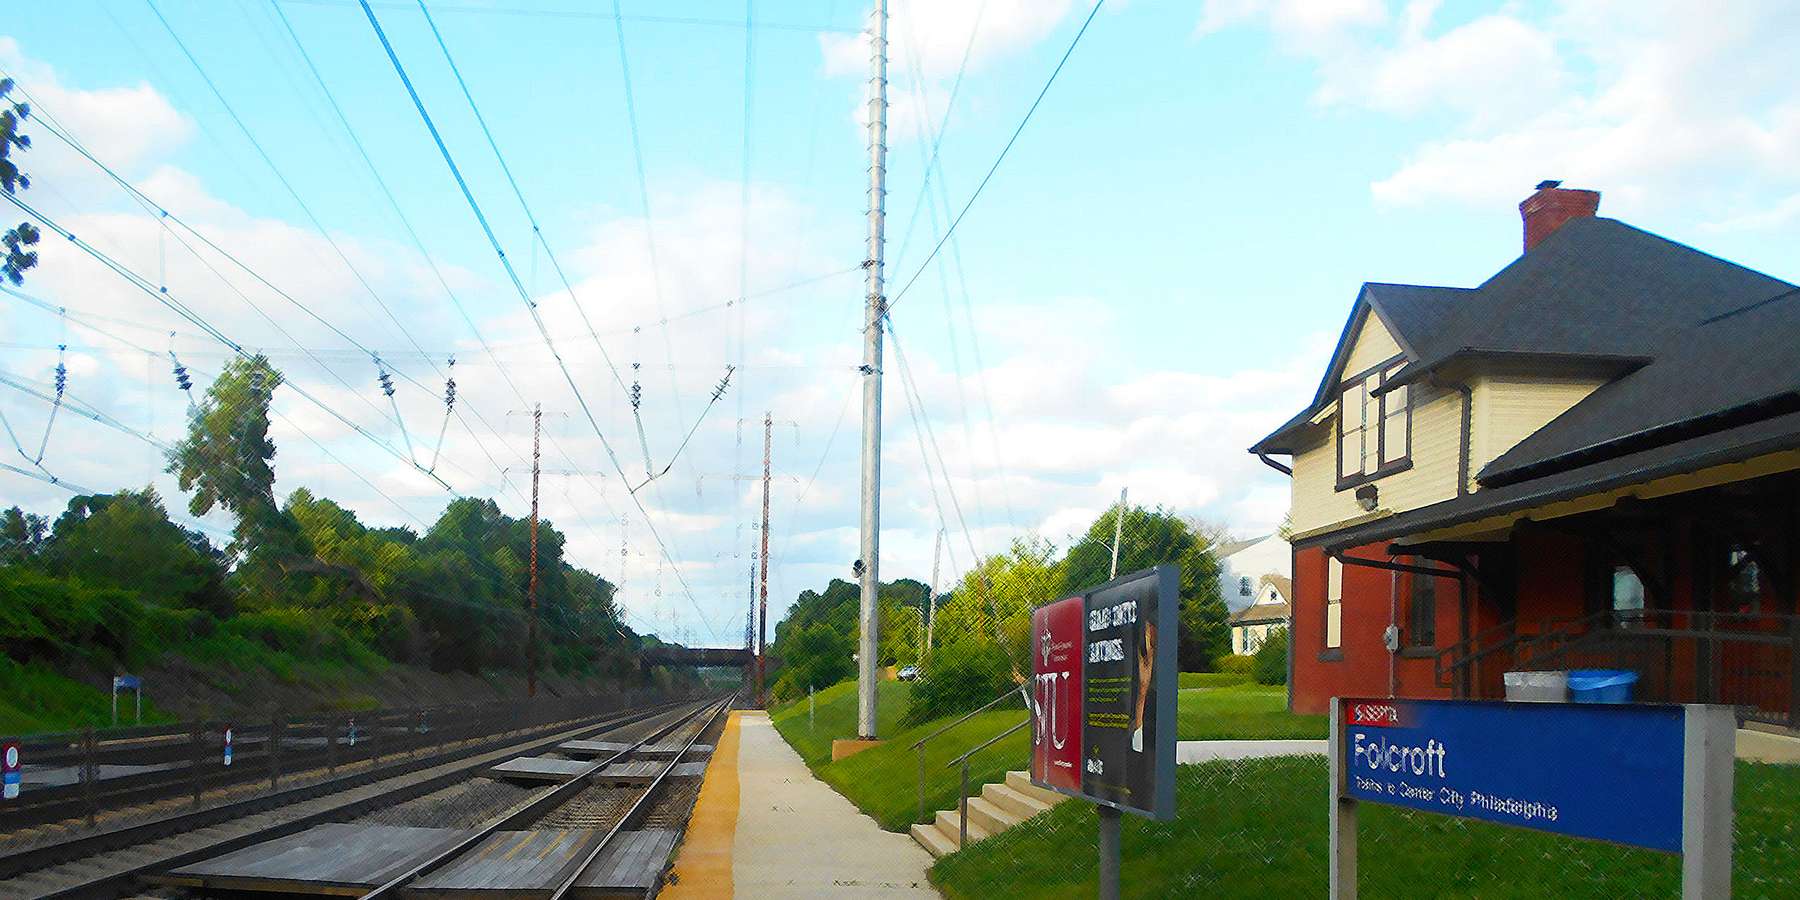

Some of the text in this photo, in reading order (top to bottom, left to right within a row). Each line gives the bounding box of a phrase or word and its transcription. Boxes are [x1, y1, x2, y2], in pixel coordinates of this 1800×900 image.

[1355, 733, 1446, 778] Folcroft
[1399, 781, 1434, 802] Center
[1439, 786, 1464, 811] City
[1470, 790, 1559, 822] Philadelphia
